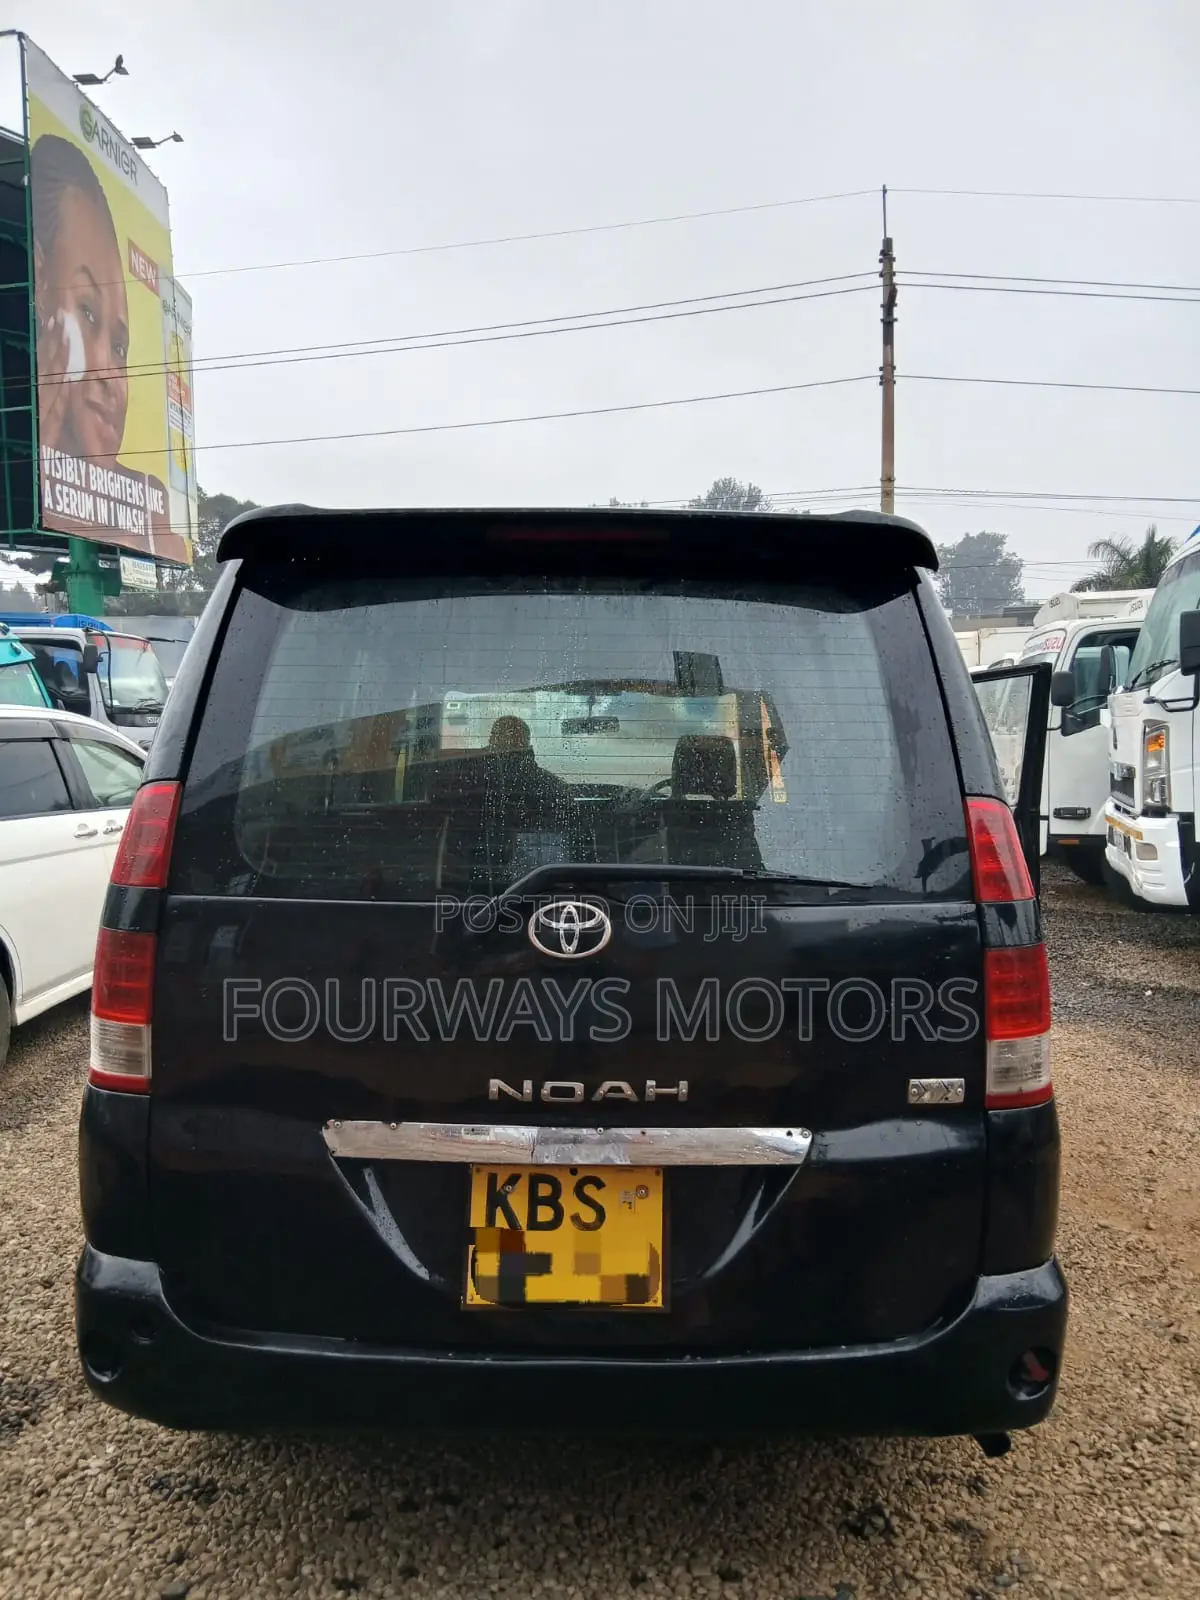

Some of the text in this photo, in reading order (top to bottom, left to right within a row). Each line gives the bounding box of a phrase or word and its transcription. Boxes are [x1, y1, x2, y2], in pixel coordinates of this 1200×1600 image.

[131, 247, 157, 288] NEW
[42, 444, 86, 488] VISIBLY
[88, 463, 145, 508] BRIGHTENS
[44, 479, 54, 510] A
[55, 483, 95, 522] SERUM
[96, 497, 109, 526] IN
[110, 501, 115, 527] 1
[116, 503, 145, 536] WASH
[488, 1078, 689, 1102] NOAH
[484, 1171, 607, 1232] KBS
